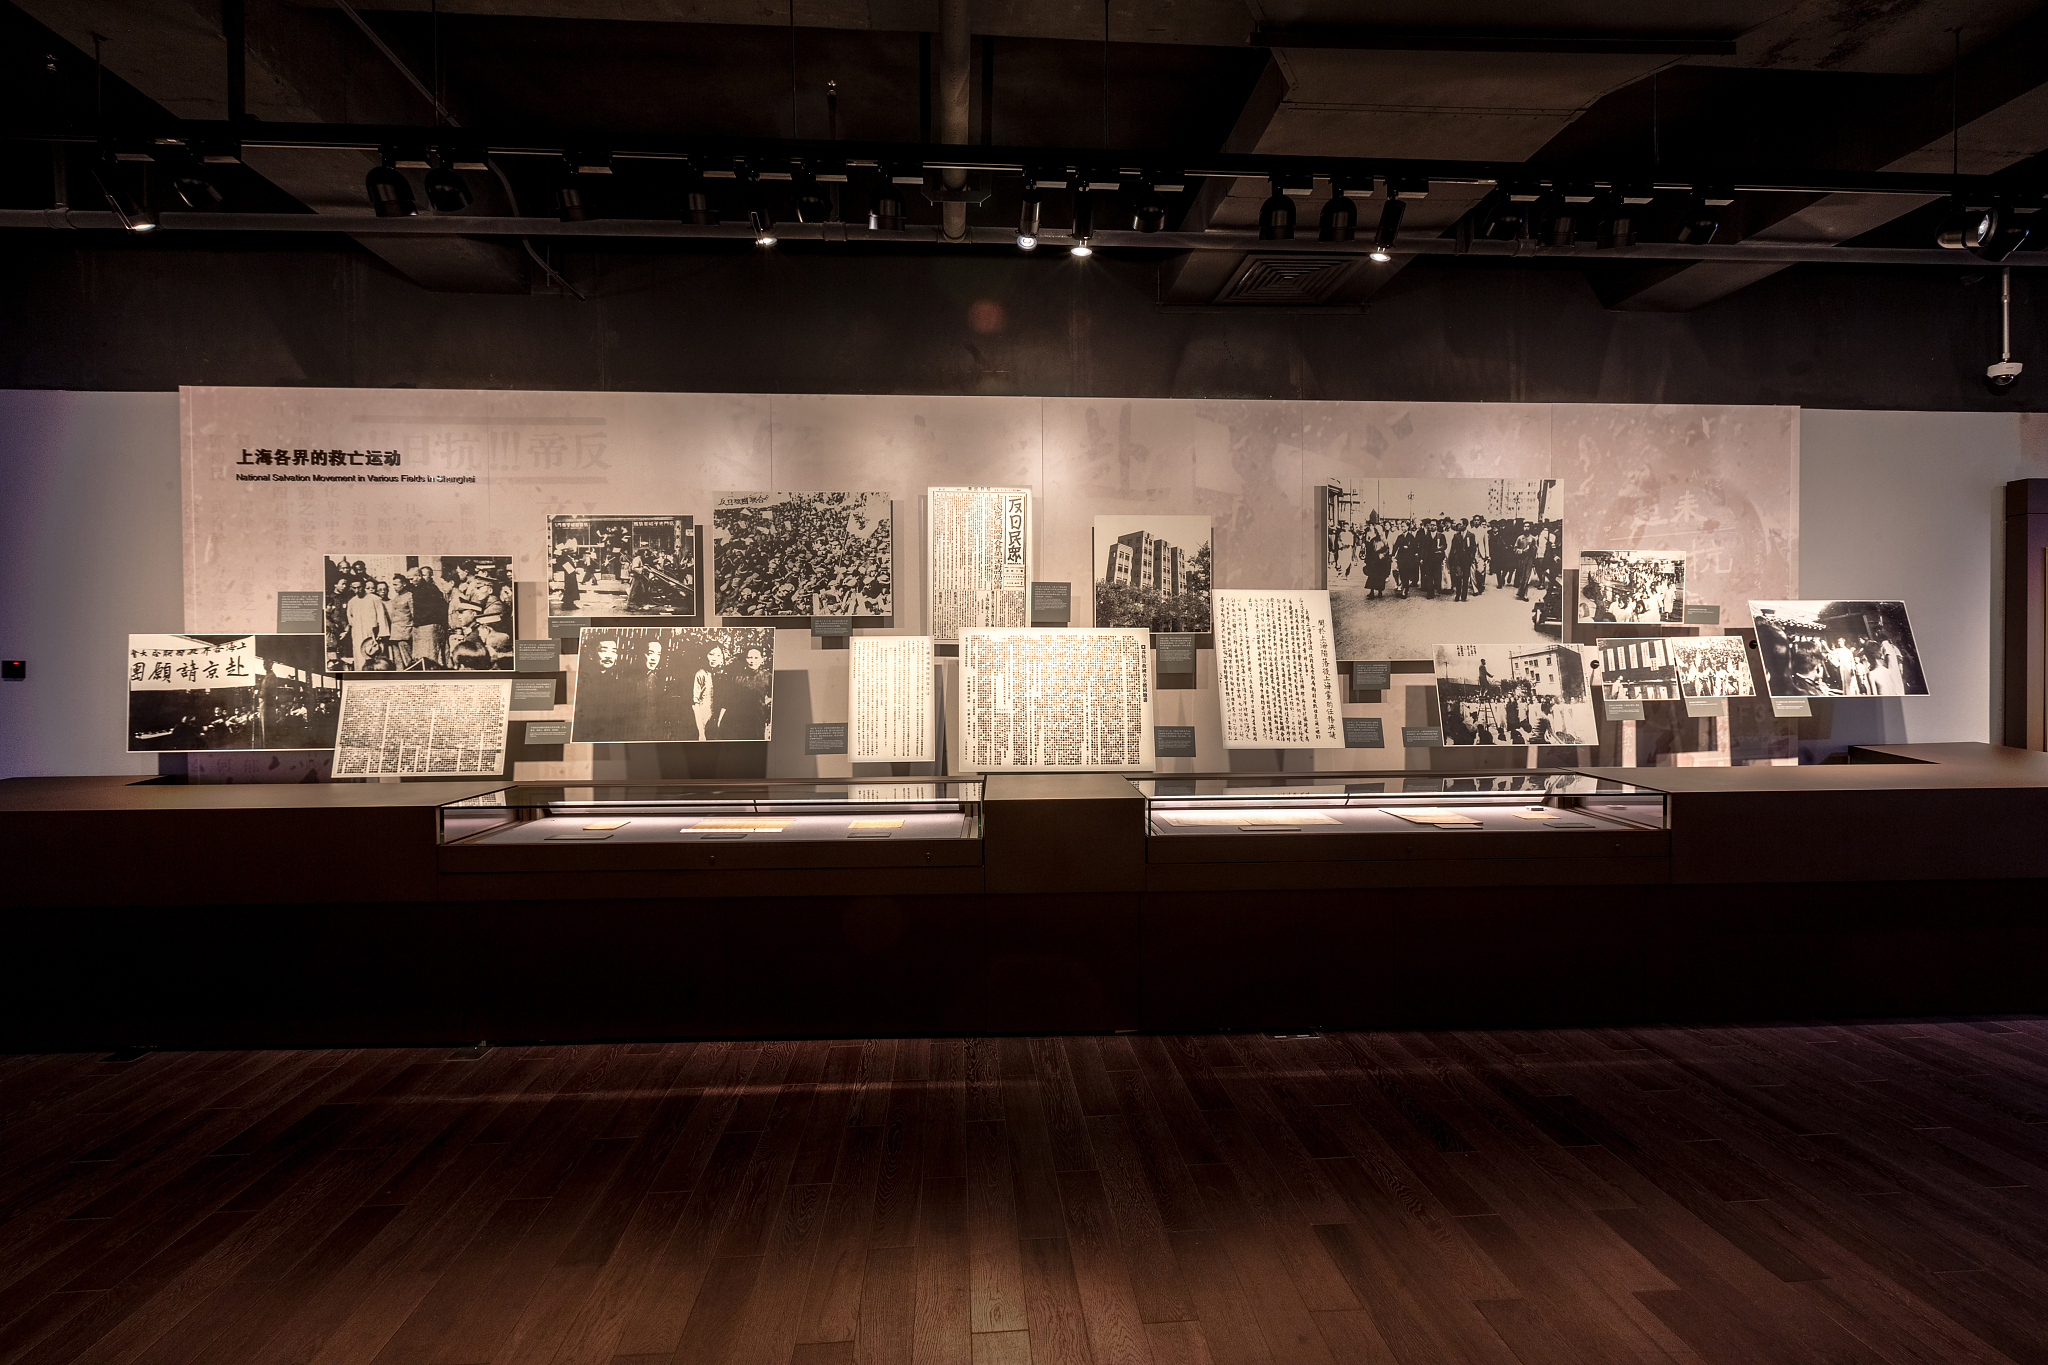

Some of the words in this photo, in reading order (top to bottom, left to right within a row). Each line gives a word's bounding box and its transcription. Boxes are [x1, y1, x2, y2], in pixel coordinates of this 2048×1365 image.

[236, 449, 401, 466] 上海各界的救亡运动
[236, 473, 271, 482] National
[272, 473, 310, 482] Salvation
[313, 474, 356, 482] Movement
[358, 474, 365, 482] in
[367, 474, 399, 482] Various
[401, 474, 426, 483] Fields
[427, 474, 435, 483] in
[437, 474, 476, 484] Shanghai
